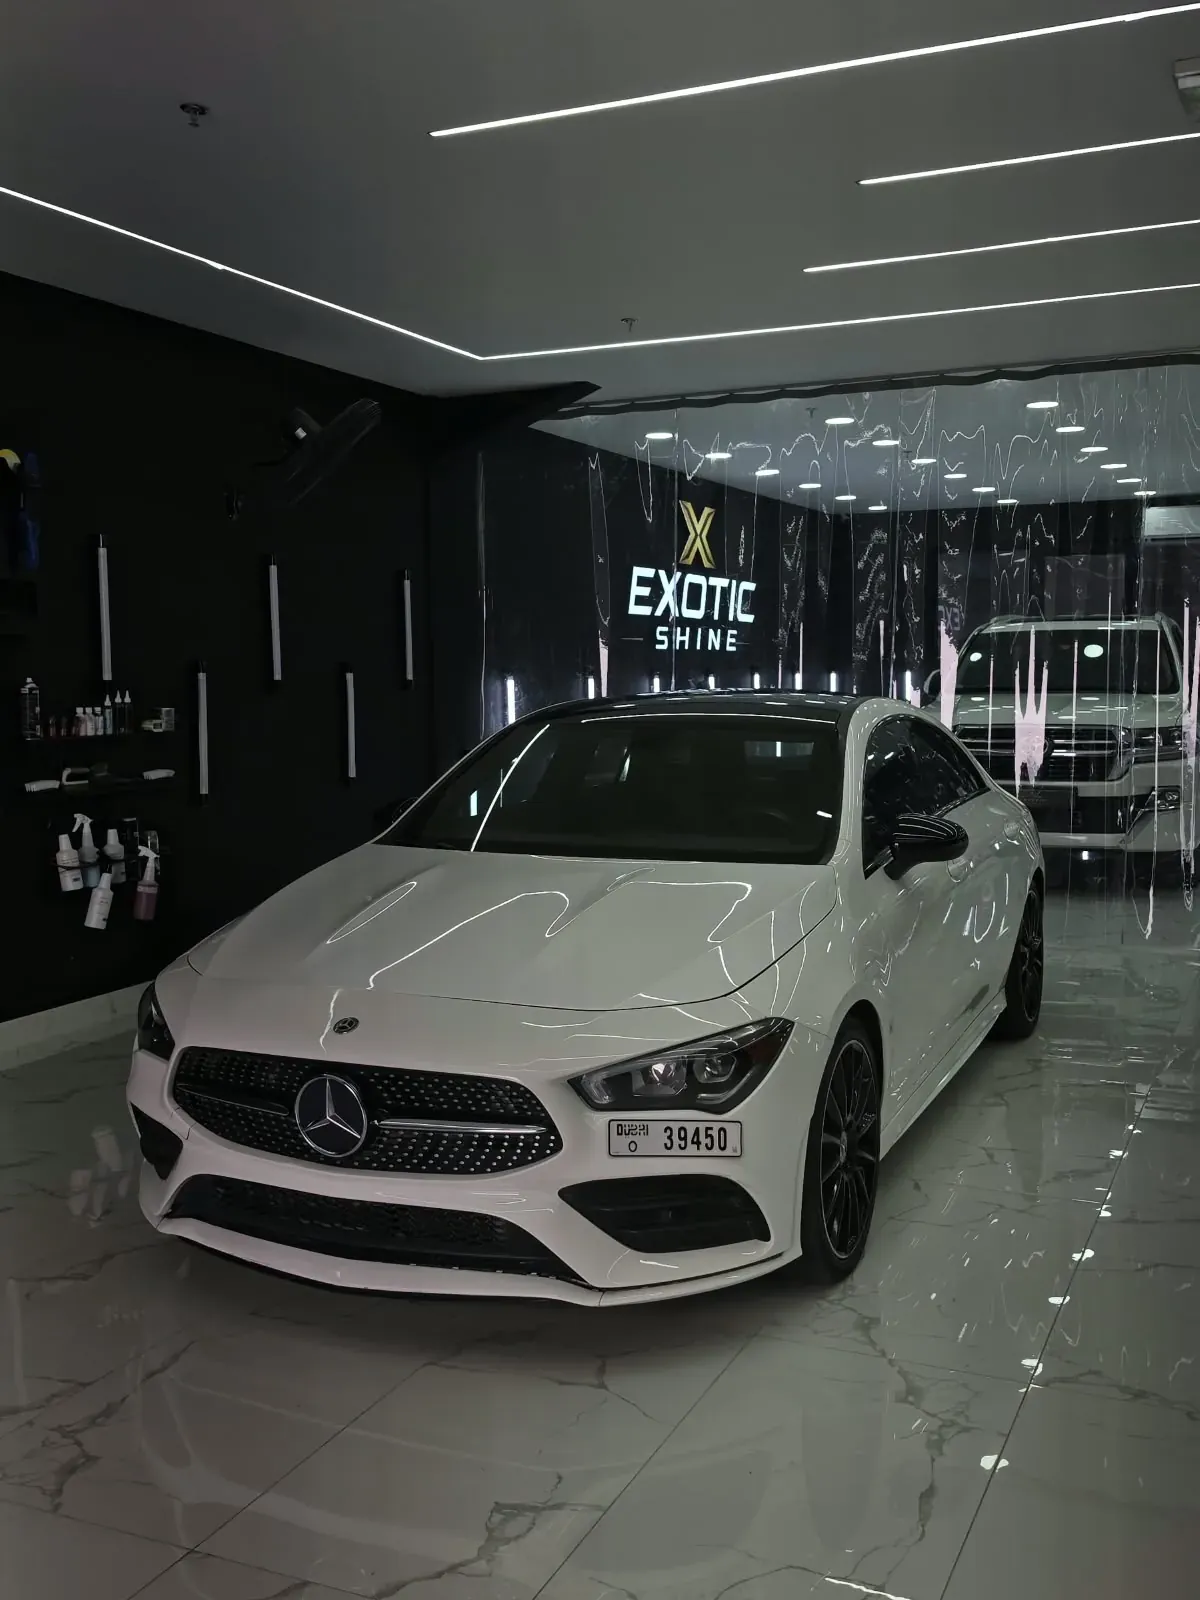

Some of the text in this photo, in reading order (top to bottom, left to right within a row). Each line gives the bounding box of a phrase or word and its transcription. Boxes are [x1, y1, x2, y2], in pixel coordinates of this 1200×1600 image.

[679, 500, 717, 569] X
[628, 566, 757, 623] EXOTIC
[655, 626, 738, 651] SHINE
[663, 1127, 727, 1151] 39450
